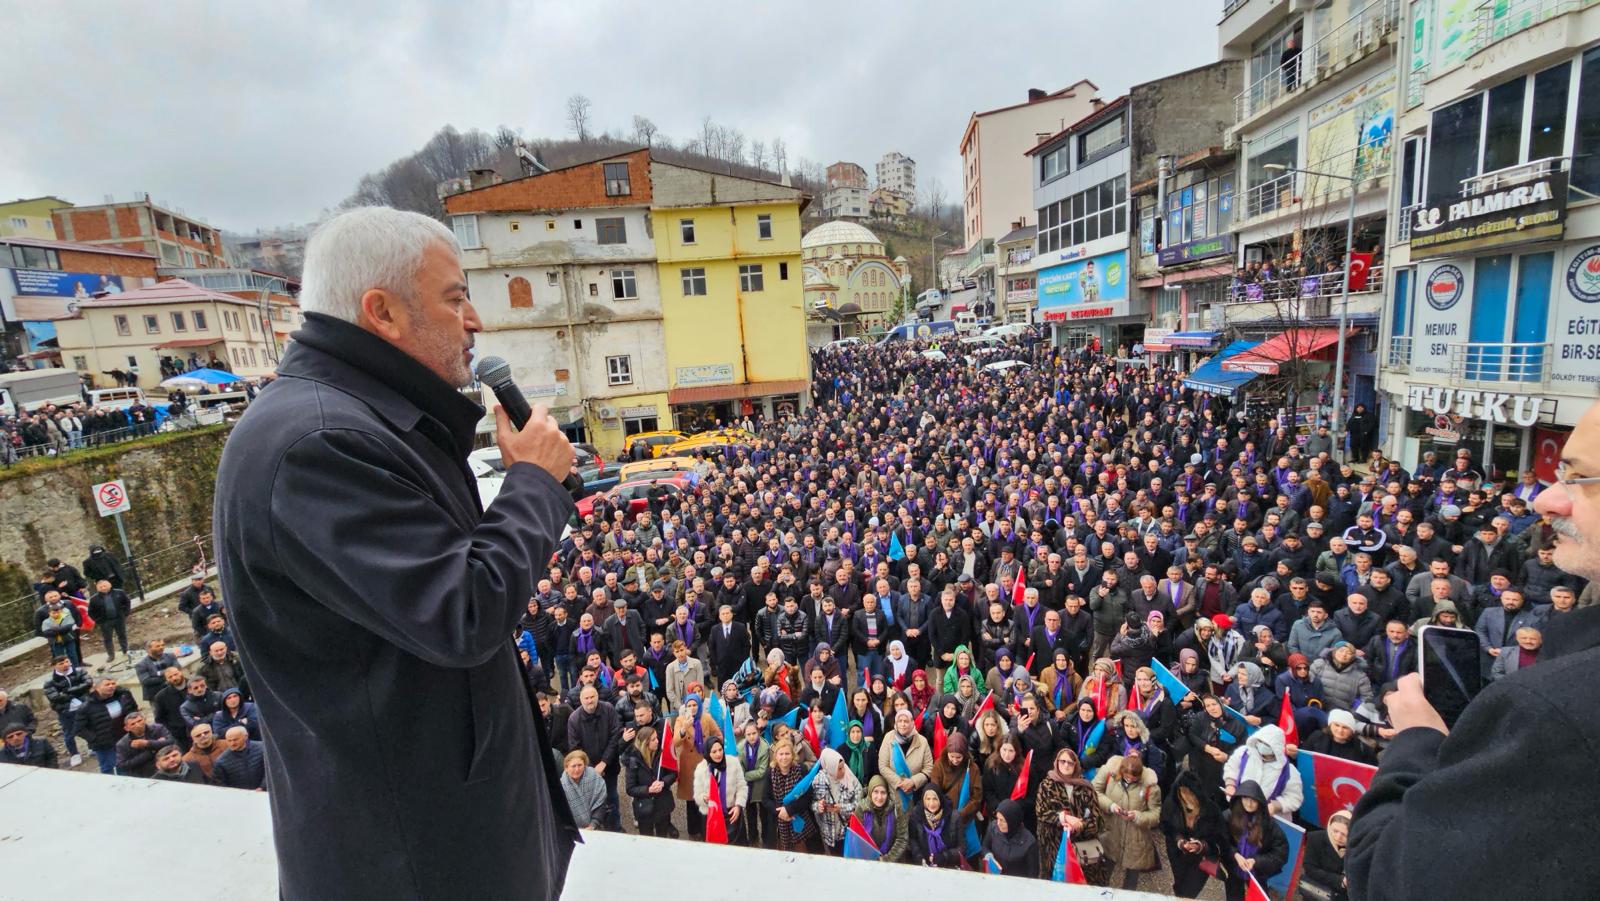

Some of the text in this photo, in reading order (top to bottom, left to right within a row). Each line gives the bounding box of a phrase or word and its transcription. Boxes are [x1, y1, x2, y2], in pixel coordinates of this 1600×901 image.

[1425, 323, 1458, 336] MEMUR
[1430, 343, 1448, 356] SEN
[1410, 385, 1543, 427] TUTKU
